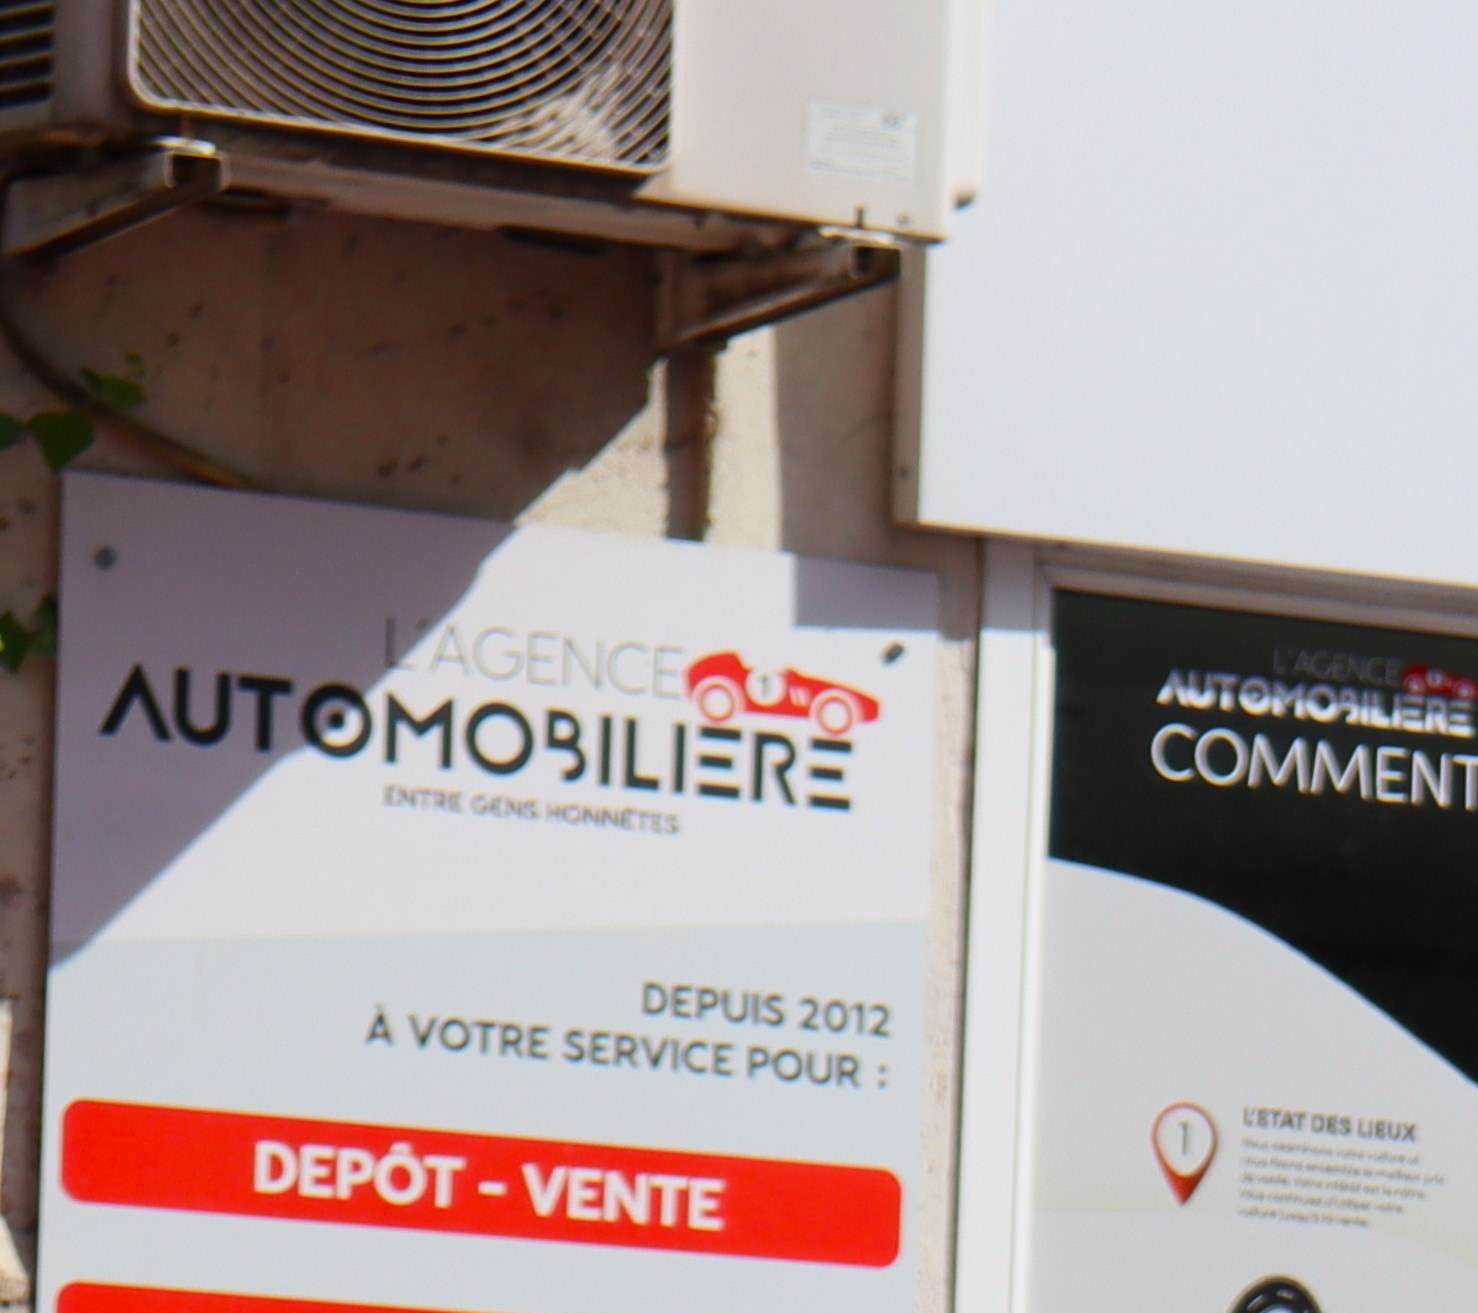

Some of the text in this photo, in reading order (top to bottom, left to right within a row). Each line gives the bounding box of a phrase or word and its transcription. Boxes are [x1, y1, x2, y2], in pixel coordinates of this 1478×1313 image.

[384, 615, 687, 699] L'AGENCE
[383, 786, 680, 836] ENTRE GENS HONNÊTES
[641, 981, 891, 1038] DEPUIS 2012
[366, 1005, 394, 1046] À
[410, 1016, 553, 1060] VOTRE
[564, 1029, 733, 1077] SERVICE
[746, 1046, 860, 1088] POUR
[1311, 1113, 1351, 1137] DES
[1359, 1117, 1416, 1143] LIEUX
[253, 1139, 466, 1209] DEPÔT
[522, 1163, 725, 1231] VENTE
